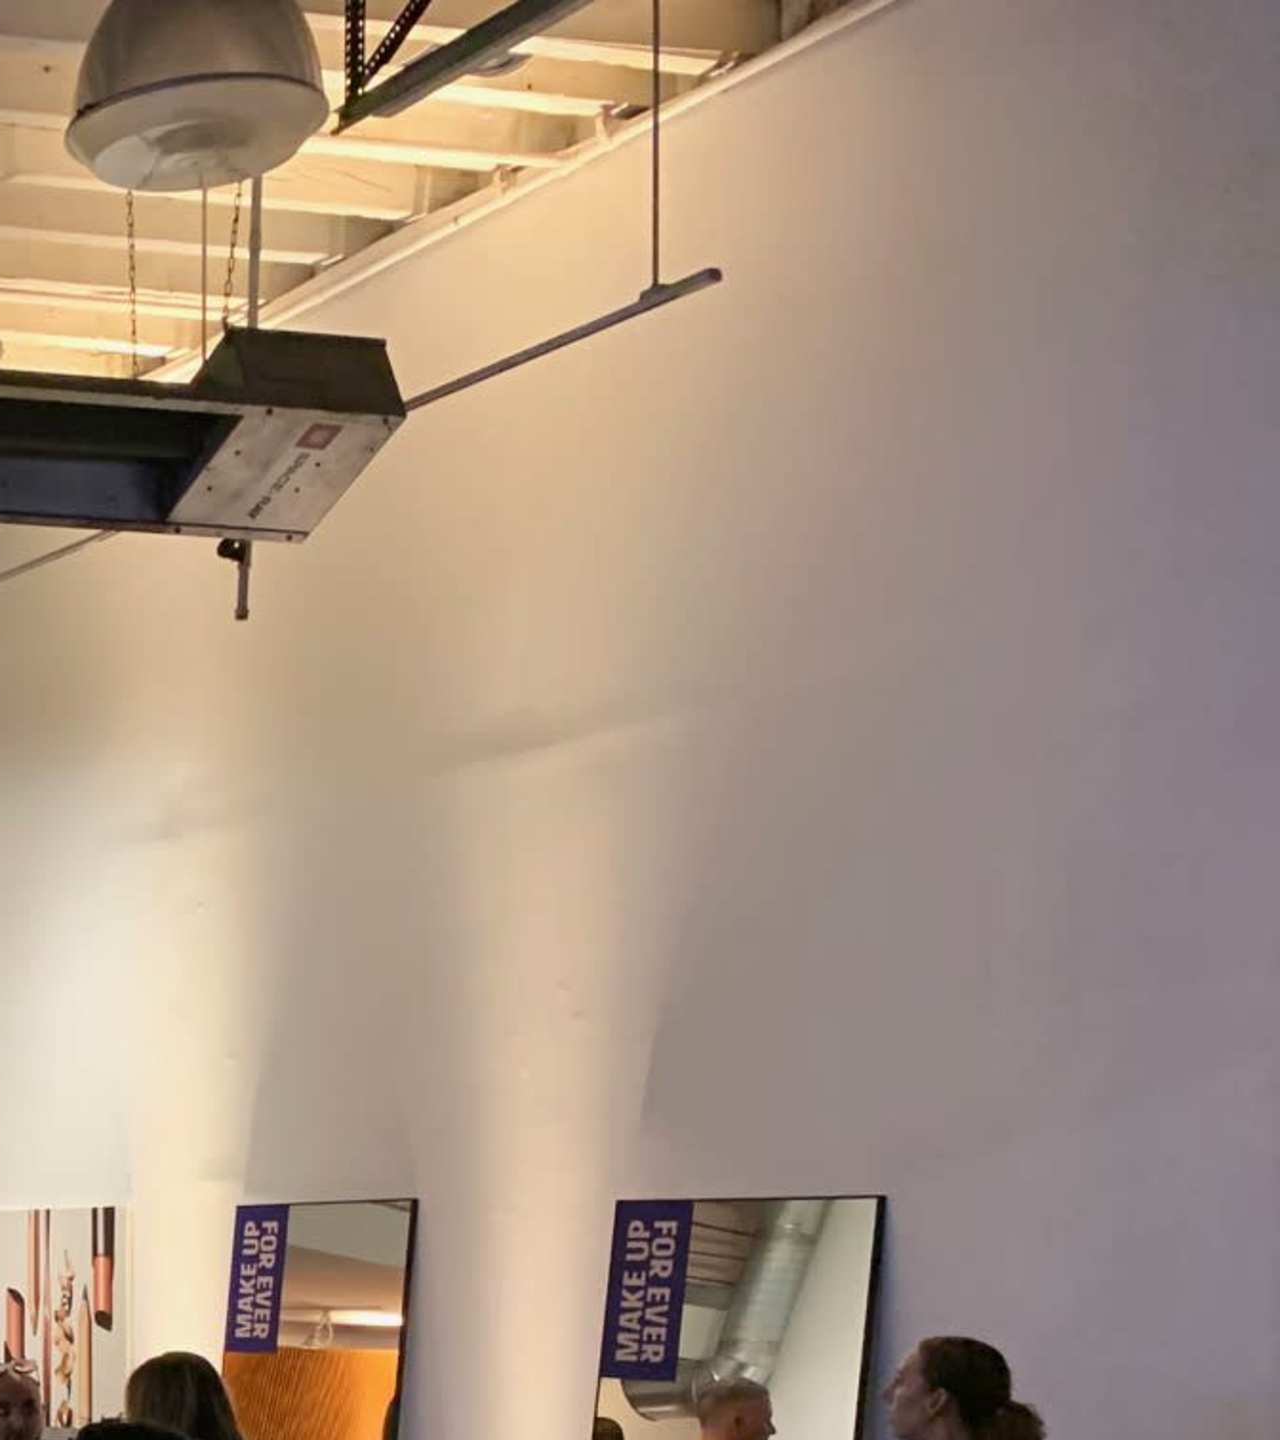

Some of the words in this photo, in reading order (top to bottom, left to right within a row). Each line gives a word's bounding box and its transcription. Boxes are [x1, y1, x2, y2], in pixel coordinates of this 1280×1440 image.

[241, 1221, 260, 1256] UP
[259, 1221, 279, 1269] FOR
[625, 1219, 651, 1262] UP
[648, 1220, 678, 1279] FOR
[235, 1263, 257, 1338] MAKE
[252, 1275, 274, 1338] EVER
[615, 1271, 647, 1362] MAKE
[640, 1286, 671, 1363] EVER
